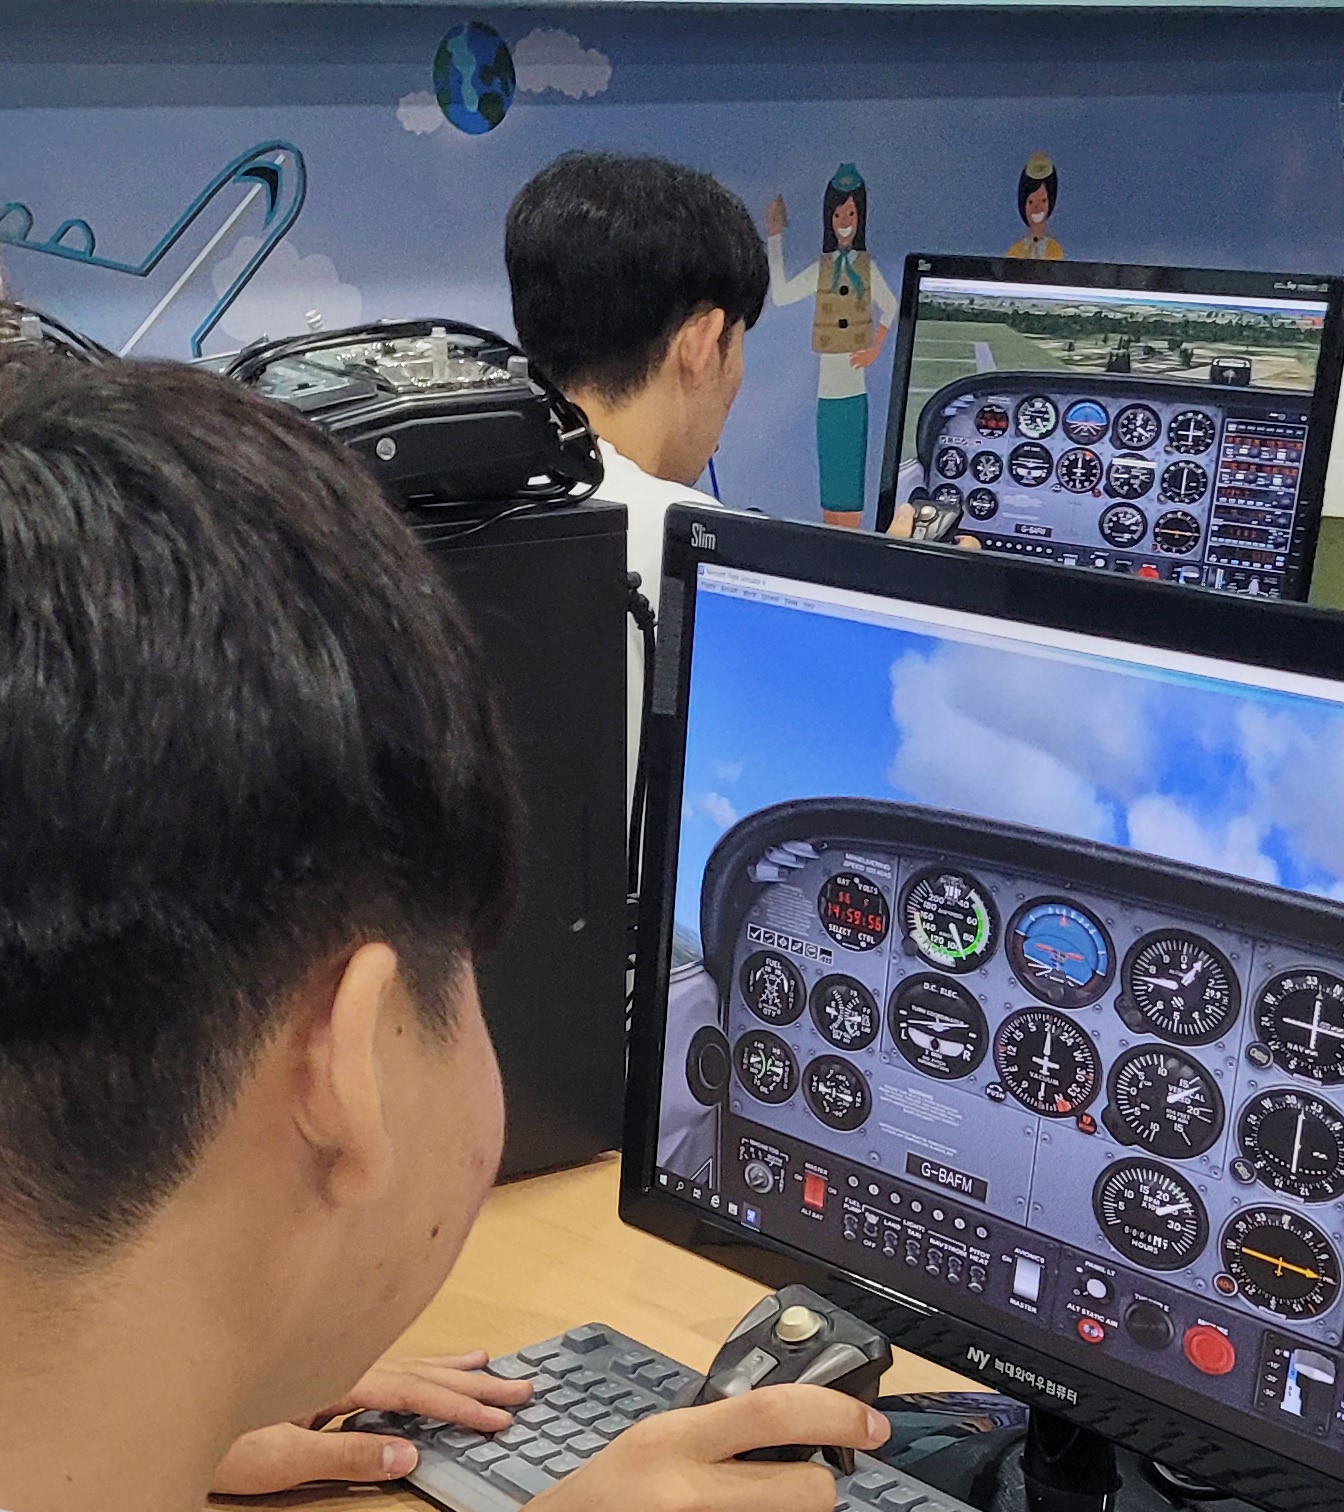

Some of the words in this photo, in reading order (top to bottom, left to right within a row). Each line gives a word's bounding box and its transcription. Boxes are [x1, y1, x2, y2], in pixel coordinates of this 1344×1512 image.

[691, 522, 716, 551] Slim
[928, 893, 945, 905] 200
[957, 896, 970, 909] 40
[922, 922, 936, 932] 140
[966, 916, 978, 926] 60
[828, 923, 852, 937] SELECT
[1044, 1022, 1056, 1034] 21
[1012, 1029, 1024, 1041] 15
[1059, 1032, 1075, 1046] 24
[1006, 1045, 1017, 1056] 12
[1072, 1049, 1085, 1062] W
[1075, 1067, 1087, 1082] 30
[1157, 1067, 1168, 1077] 10
[1179, 1078, 1190, 1089] 15
[1186, 1105, 1200, 1116] 20
[1149, 1122, 1160, 1133] 10
[1173, 1122, 1184, 1133] 15
[921, 1162, 973, 1193] G-BAFM
[1123, 1188, 1135, 1199] 10
[1139, 1184, 1151, 1195] 15
[844, 1196, 862, 1208] FUEL
[1155, 1190, 1170, 1202] 20
[1166, 1219, 1182, 1232] 30
[1131, 1238, 1159, 1255] HOURS
[1009, 1296, 1038, 1315] MASTER
[1066, 1302, 1081, 1313] ALT
[1081, 1307, 1106, 1323] STATIC
[1105, 1317, 1119, 1329] AIR
[994, 1358, 1078, 1406] 늑대와여우컴퓨터
